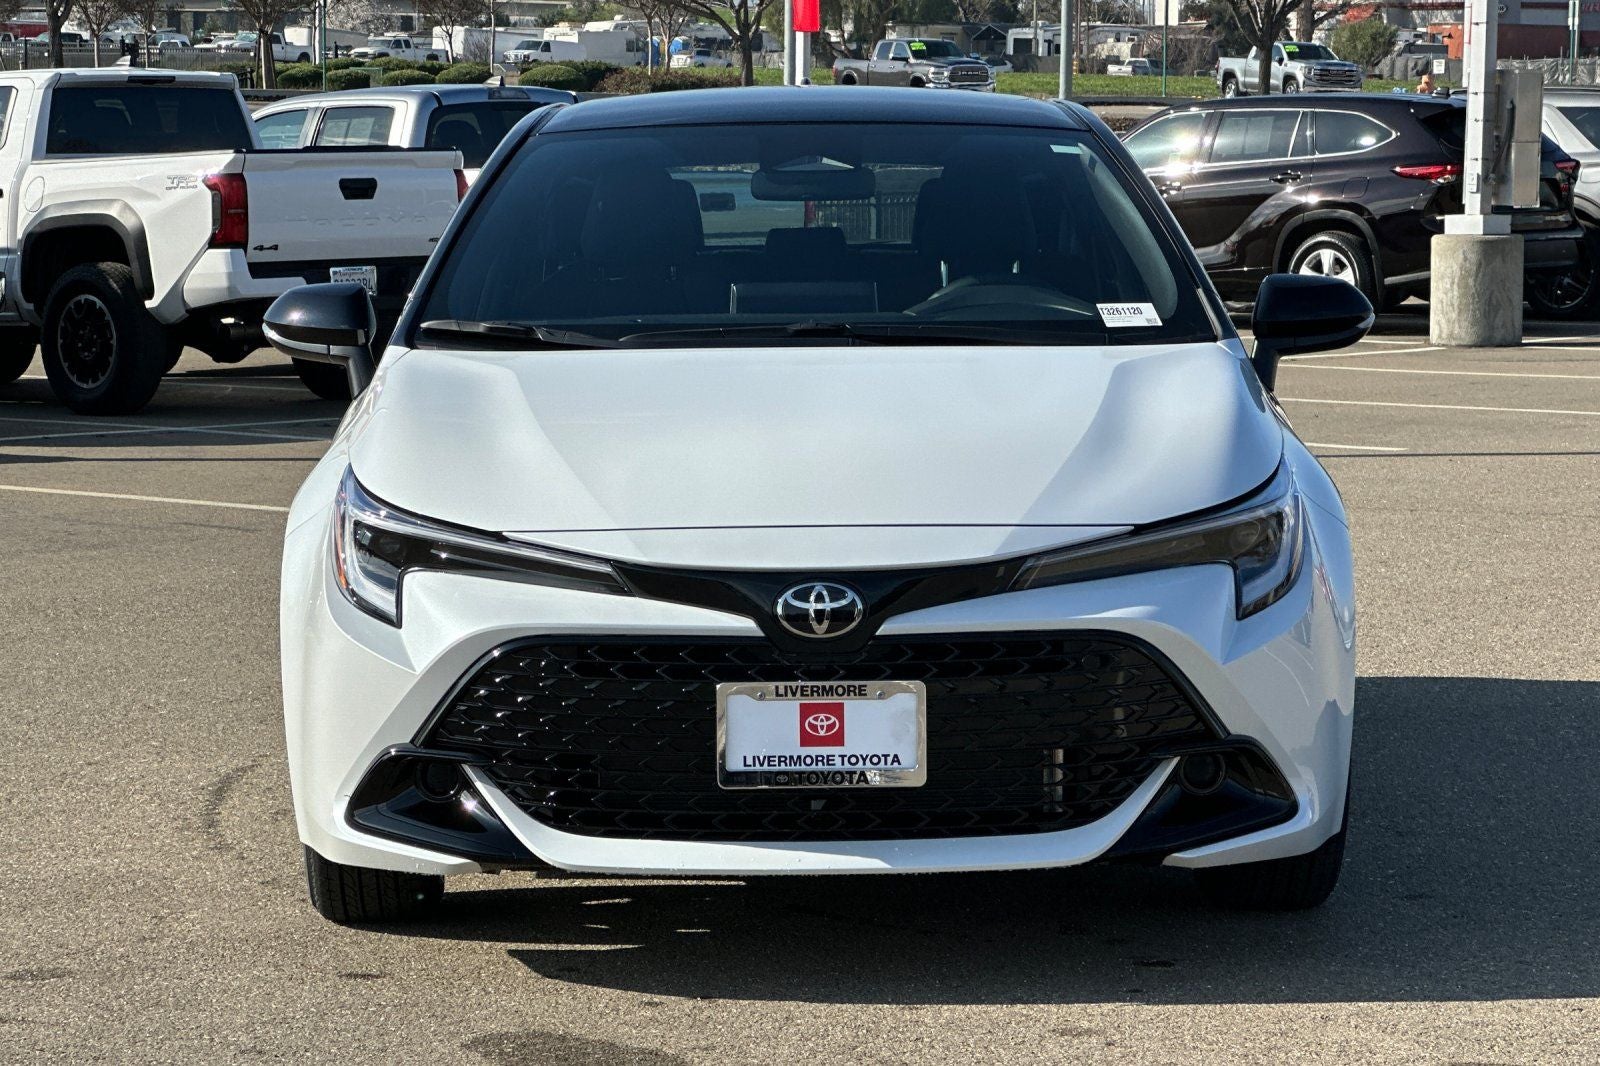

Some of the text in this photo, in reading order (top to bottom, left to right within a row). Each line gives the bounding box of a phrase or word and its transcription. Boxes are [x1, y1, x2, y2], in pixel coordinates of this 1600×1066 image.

[1099, 306, 1143, 316] T3261120
[775, 684, 868, 698] LIVERMORE
[743, 753, 901, 767] LIVERMORE TOYOTA
[795, 770, 870, 785] TOYOTA
